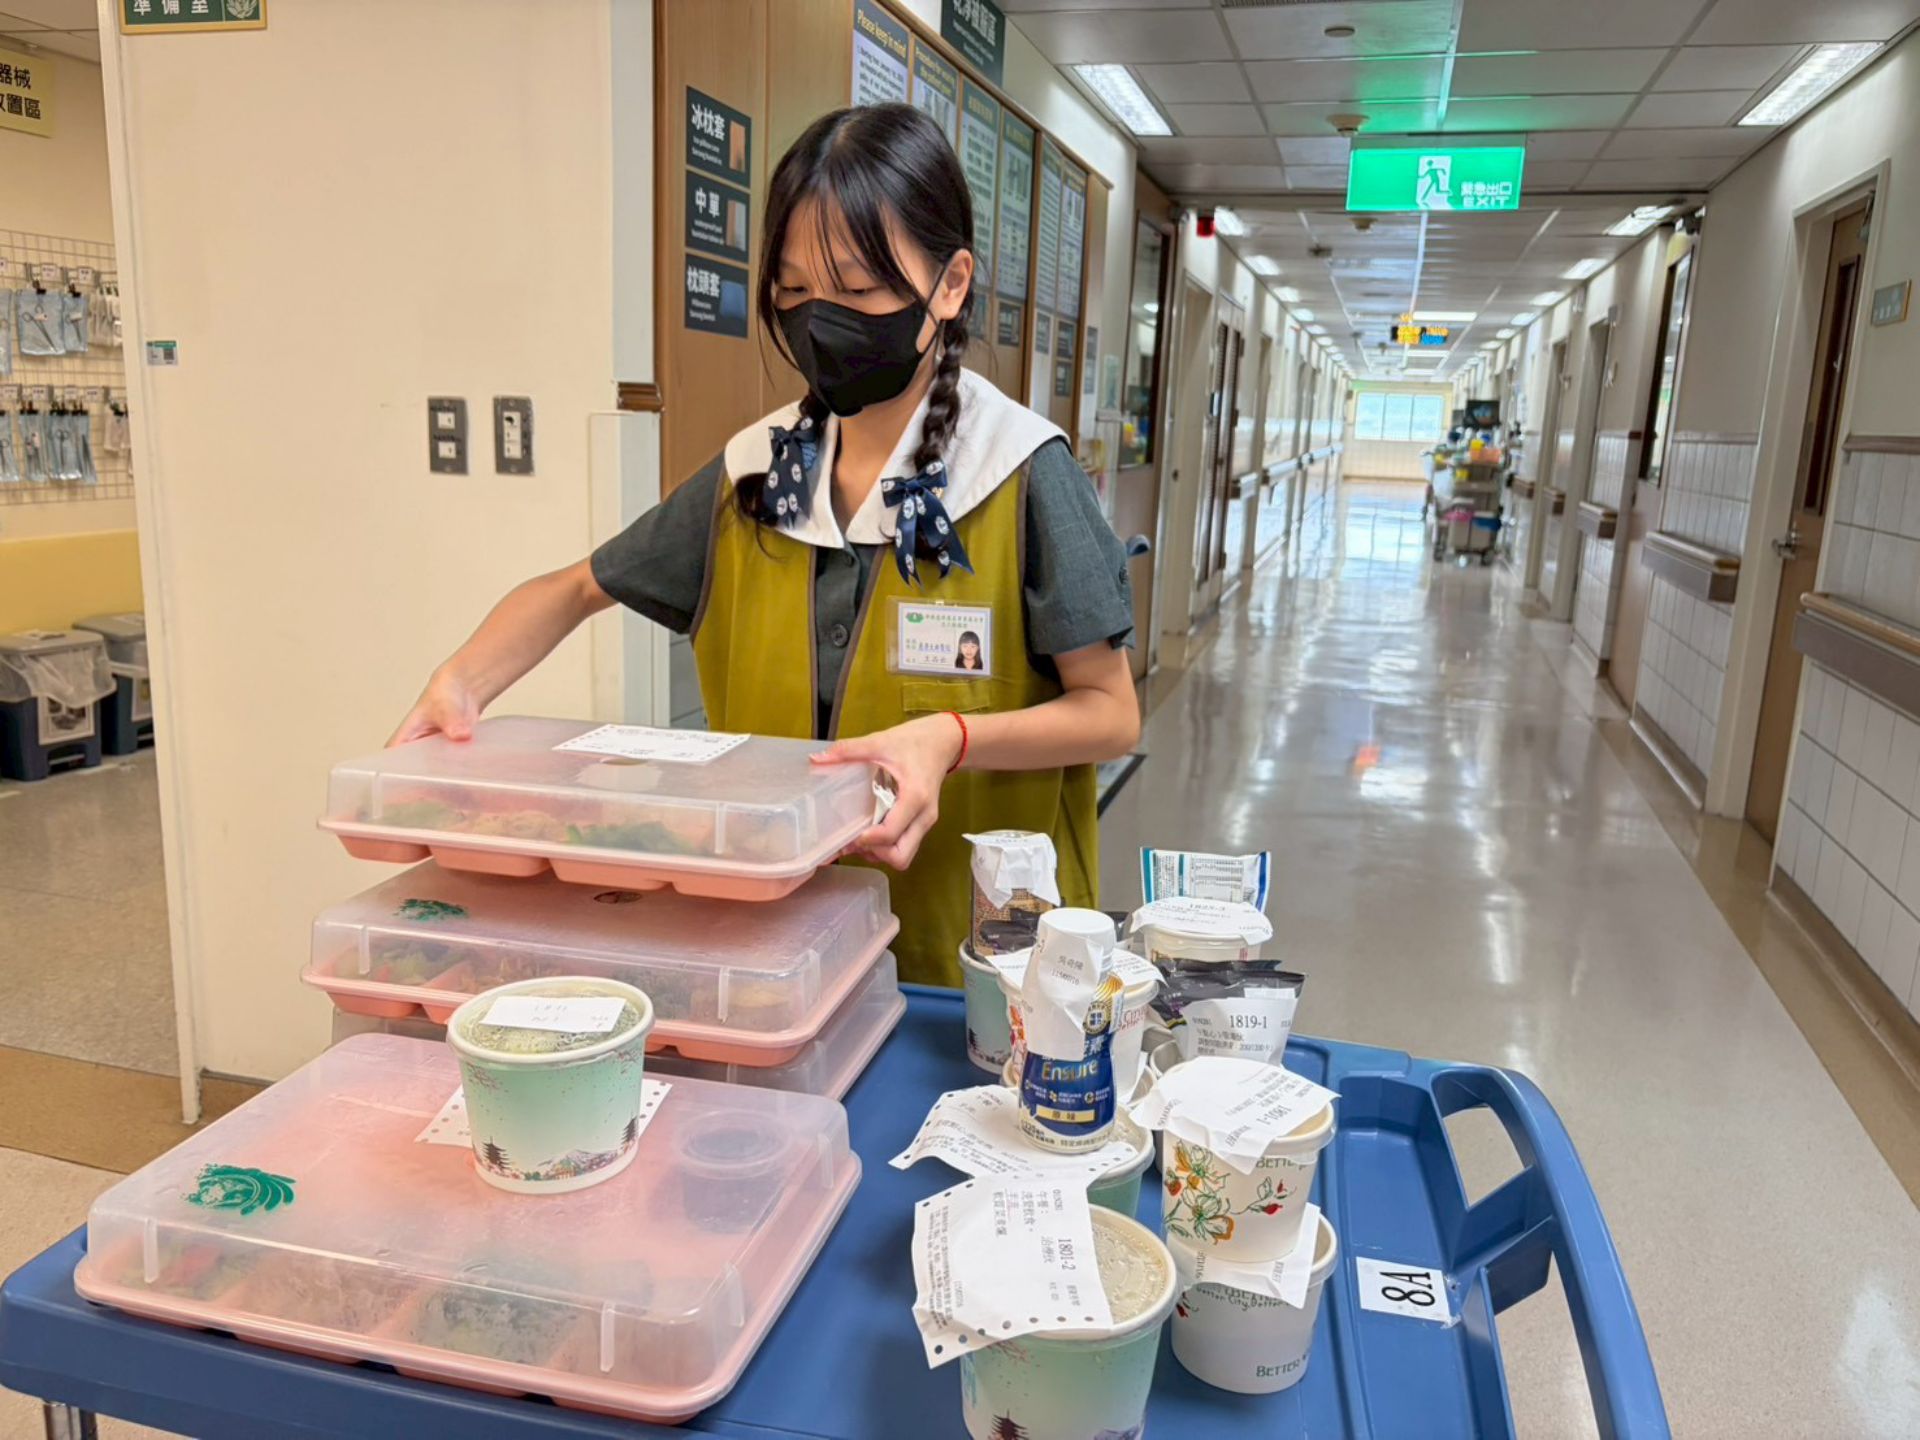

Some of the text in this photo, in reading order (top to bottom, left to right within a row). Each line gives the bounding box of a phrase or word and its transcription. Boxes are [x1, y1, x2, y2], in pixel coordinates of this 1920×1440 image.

[691, 103, 725, 141] 冰枕套
[1463, 195, 1510, 209] EXIT
[687, 265, 720, 298] 枕頭套
[1230, 1014, 1267, 1029] 1819-1
[1042, 1060, 1099, 1082] Ensure
[1058, 1238, 1077, 1271] 1801-2
[1379, 1270, 1435, 1307] 8A
